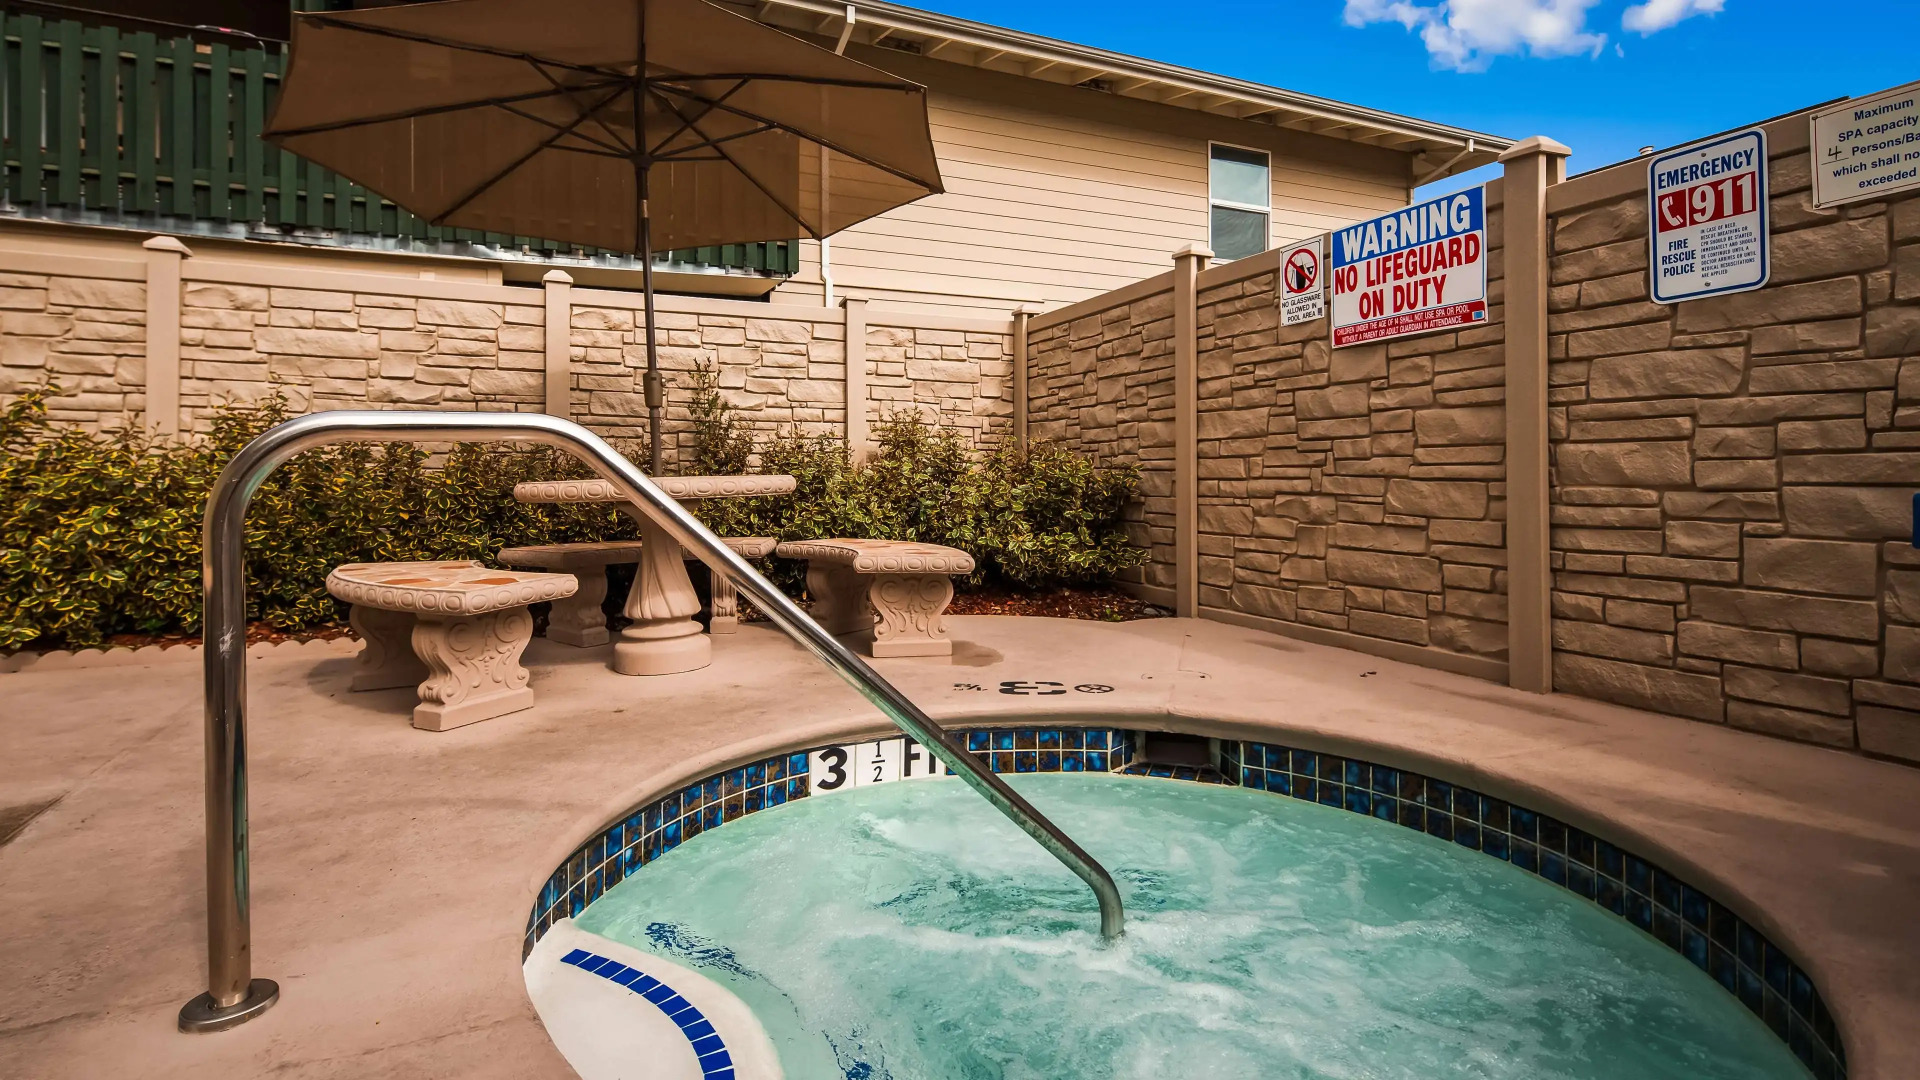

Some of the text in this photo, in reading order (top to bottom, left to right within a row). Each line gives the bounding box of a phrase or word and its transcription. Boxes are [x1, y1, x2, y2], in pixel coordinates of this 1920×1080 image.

[1854, 99, 1914, 121] Maximum
[1838, 116, 1919, 143] SPA capacity
[1828, 146, 1842, 160] 4
[1657, 148, 1754, 190] EMERGENCY
[1833, 162, 1867, 177] which
[1871, 154, 1900, 169] shall
[1859, 167, 1917, 188] exceeded
[1692, 174, 1753, 223] 911
[1342, 194, 1470, 263] WARNING
[1701, 233, 1716, 241] RESCUE
[1718, 228, 1740, 237] BREATHING
[1669, 239, 1688, 251] FIRE
[1710, 237, 1726, 245] SHOULD
[1735, 232, 1752, 240] STARTED
[1701, 244, 1728, 253] IMMEDIATELY
[1708, 250, 1730, 258] CONTINUED
[1335, 233, 1480, 295] NO LIFEGUARD
[1661, 250, 1696, 265] RESCUE
[1701, 258, 1717, 266] DOCTOR
[1663, 263, 1695, 278] POLICE
[1710, 269, 1728, 277] APPLIED
[1291, 293, 1321, 306] GLASSWARE
[1359, 274, 1447, 320] ON DUTY
[1287, 304, 1310, 315] ALLOWED
[1288, 311, 1315, 323] POOL AREA
[1336, 327, 1355, 337] CHILDREN
[1370, 322, 1378, 330] THE
[1400, 315, 1413, 324] SHALL
[1414, 313, 1424, 321] NOT
[1425, 311, 1434, 319] USE
[1436, 309, 1445, 317] SPA
[1447, 307, 1454, 315] OR
[1456, 305, 1470, 314] POOL
[1342, 334, 1358, 344] WITHOUT
[1363, 331, 1378, 340] PARENT
[1386, 327, 1399, 336] ADULT
[1400, 322, 1422, 333] GUARDIAN
[1424, 321, 1429, 329] IN
[1430, 316, 1464, 328] ATTENDANCE.
[817, 747, 848, 790] 3
